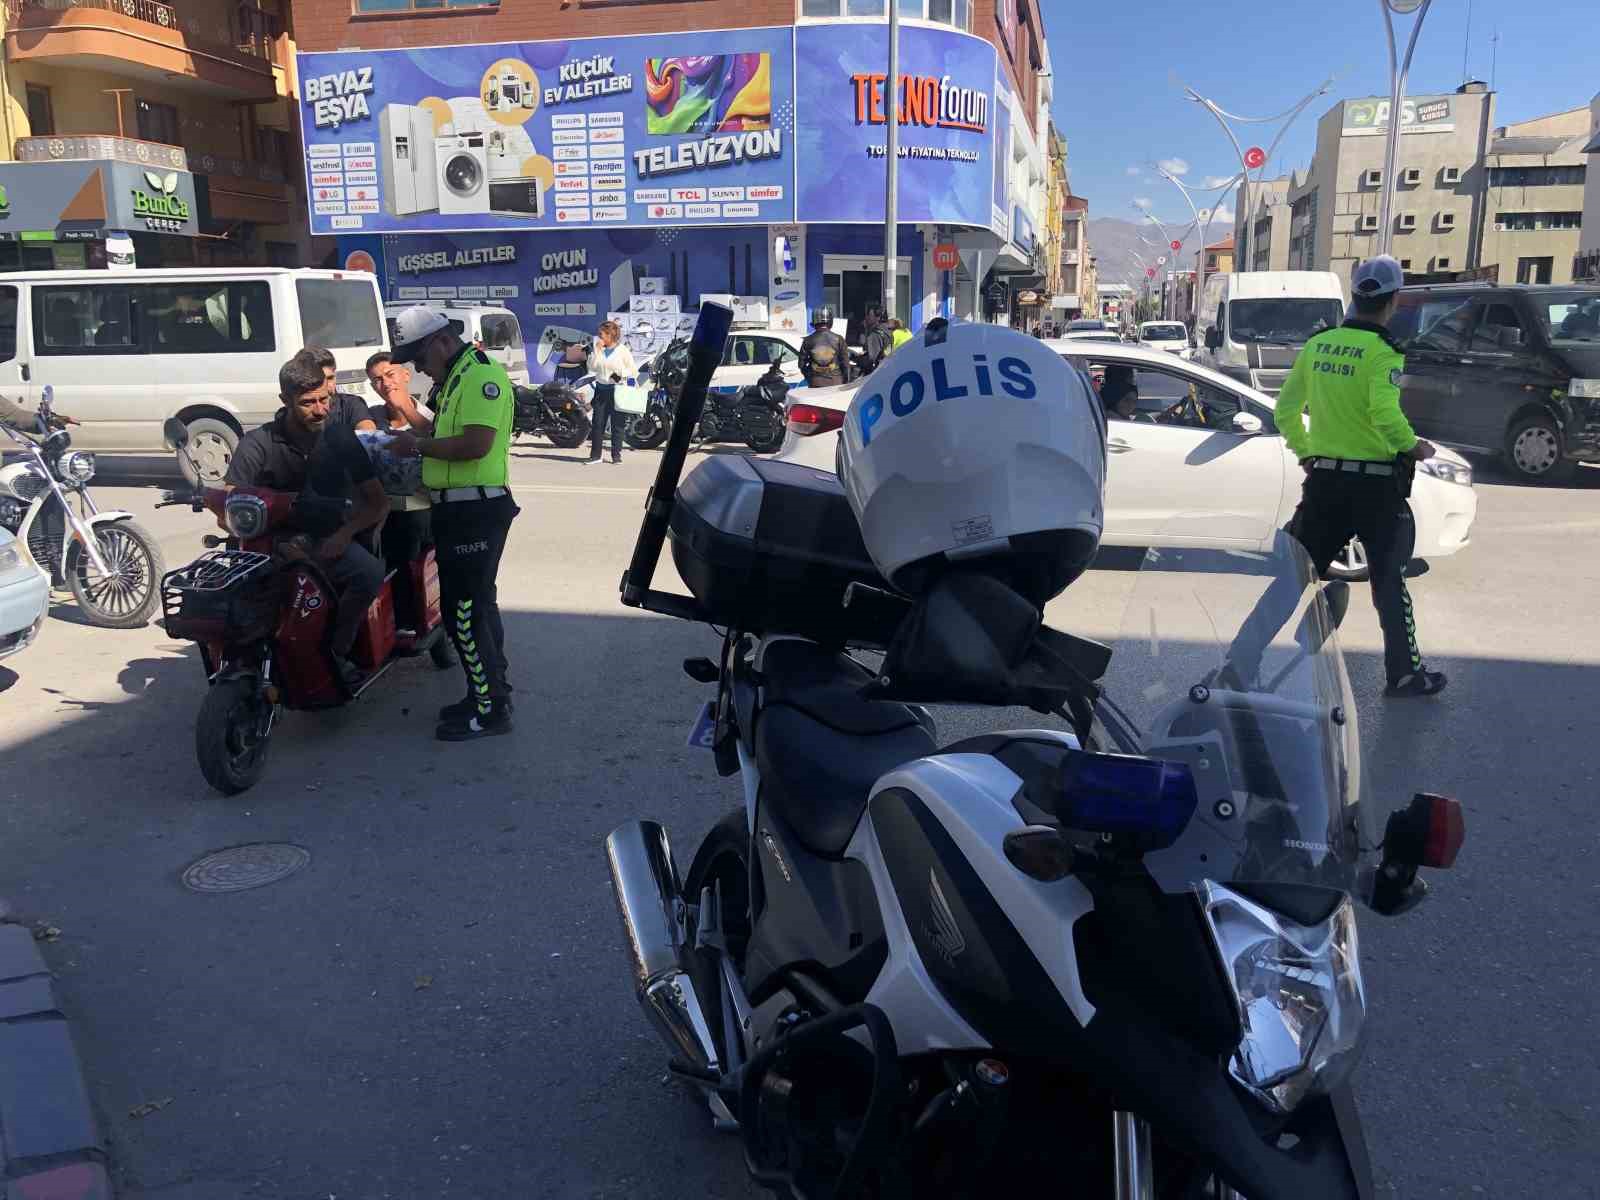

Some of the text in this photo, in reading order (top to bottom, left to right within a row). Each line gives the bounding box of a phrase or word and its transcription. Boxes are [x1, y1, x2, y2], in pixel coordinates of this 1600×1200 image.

[559, 54, 616, 84] KÜÇÜK
[304, 67, 373, 101] BEYAZ
[544, 85, 566, 104] EV
[313, 94, 371, 127] EŞYA
[633, 129, 781, 175] TELEVİZYON
[677, 191, 701, 200] TCL
[750, 188, 779, 198] simfer
[665, 207, 676, 216] LG
[454, 245, 516, 266] ALETLER
[541, 248, 587, 271] OYUN
[533, 269, 599, 292] KONSOLU
[858, 354, 1037, 449] POLİS
